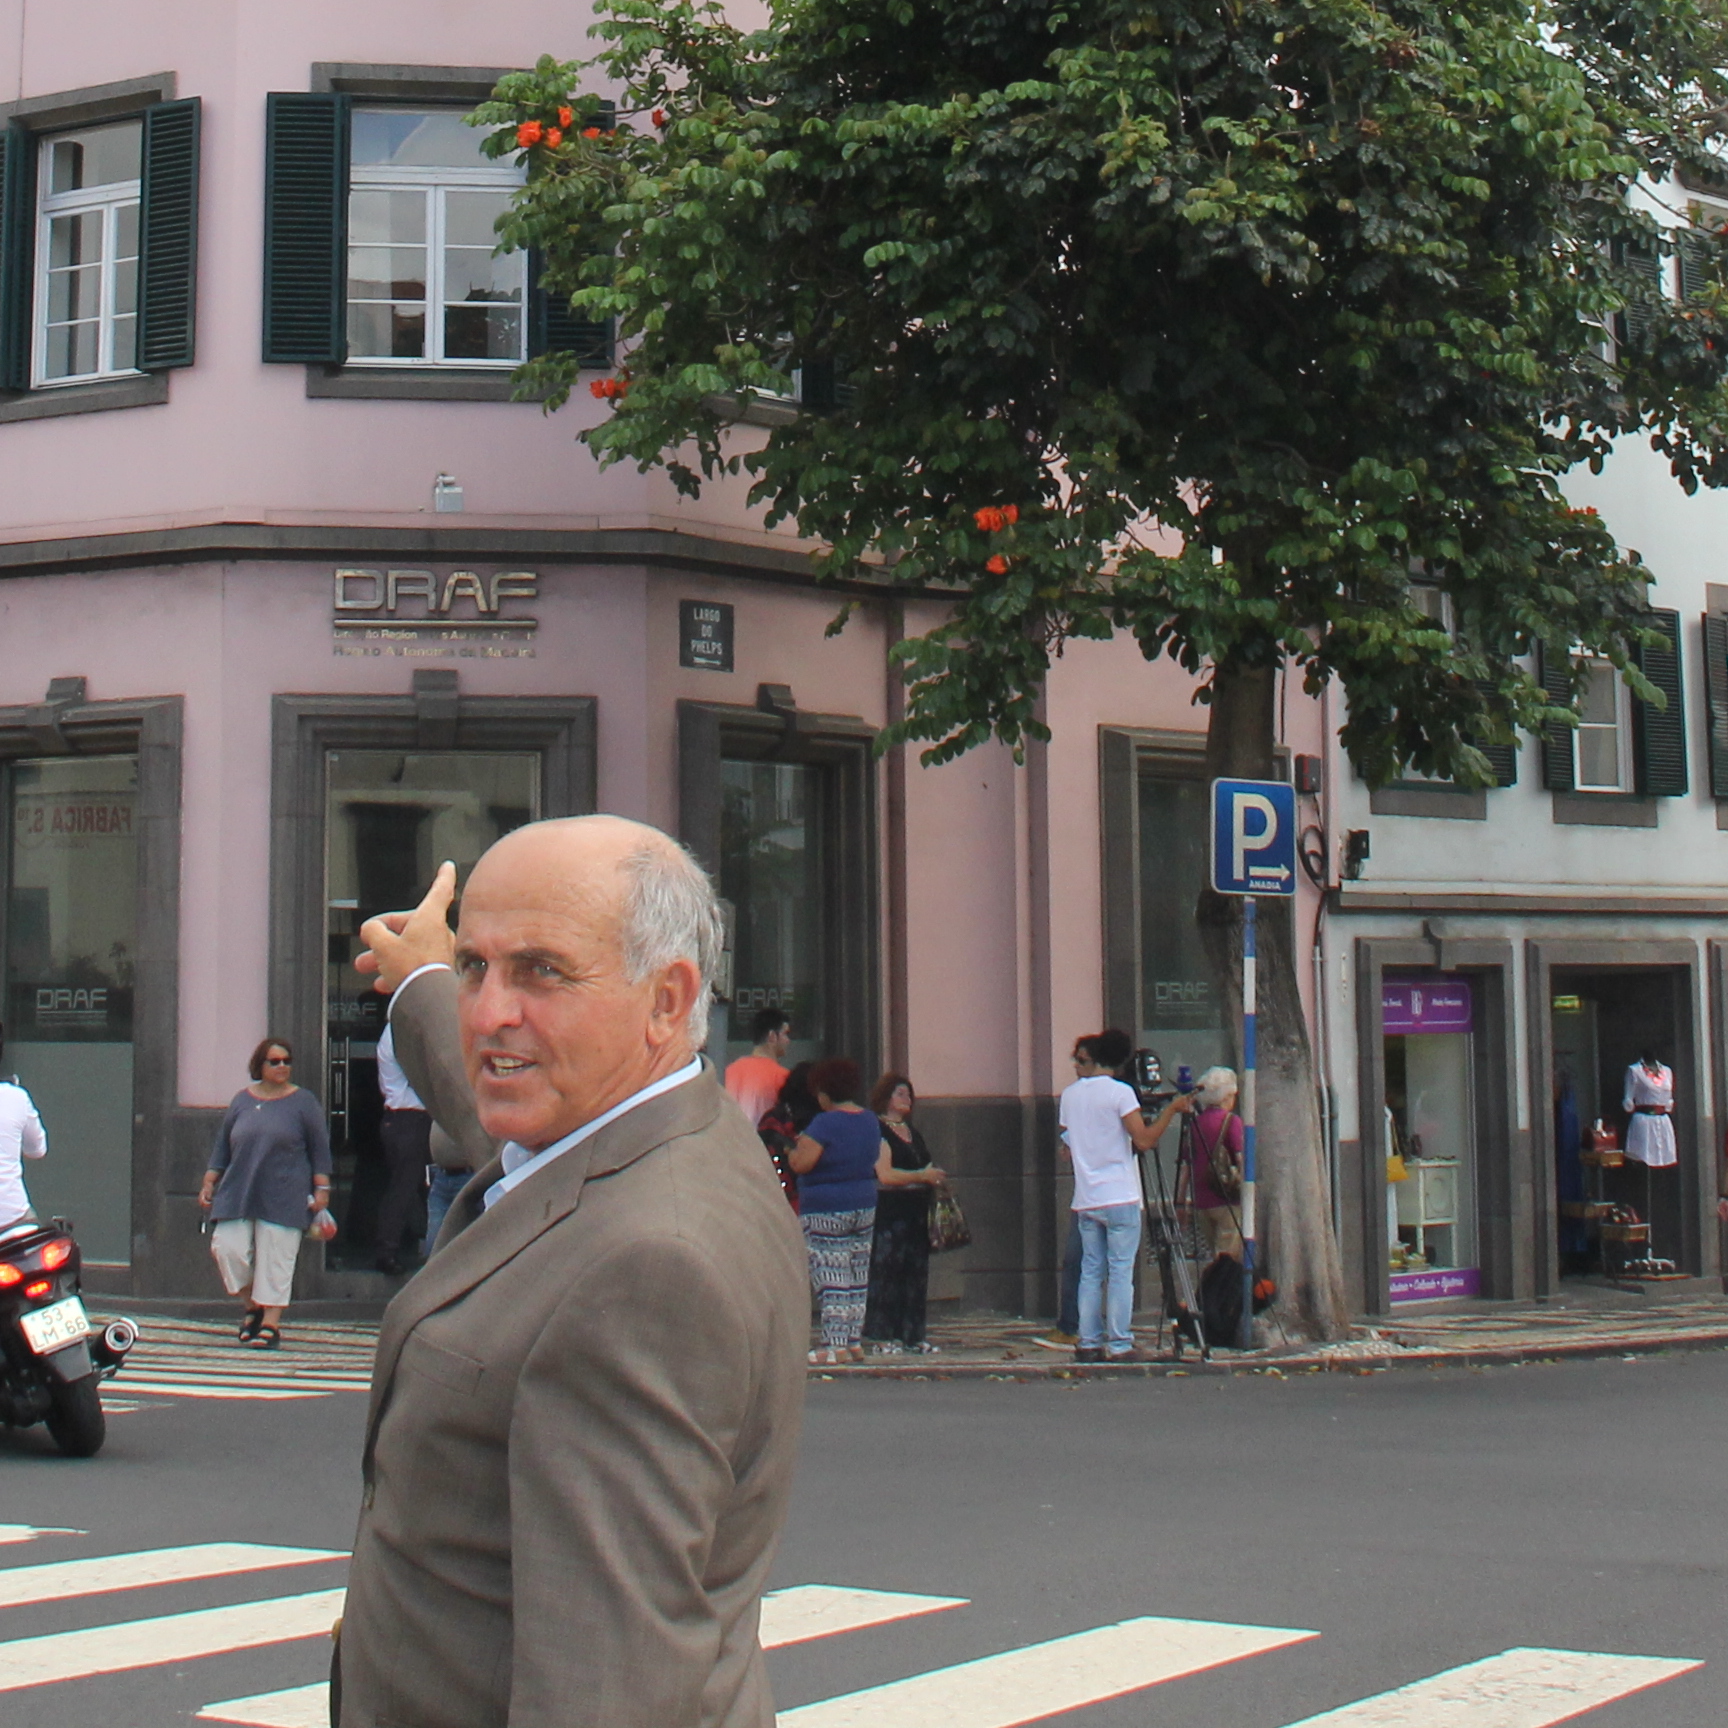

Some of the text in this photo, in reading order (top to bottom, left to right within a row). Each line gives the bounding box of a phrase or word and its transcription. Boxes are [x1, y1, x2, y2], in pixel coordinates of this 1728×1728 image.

[334, 568, 538, 612] DRAF
[693, 608, 721, 622] LARGO
[701, 624, 712, 637] DO
[691, 639, 723, 655] PHELPS
[1232, 791, 1278, 880] P
[1248, 879, 1282, 891] ANADIA
[36, 987, 108, 1010] DRAF
[735, 987, 795, 1008] DRAF
[1155, 980, 1209, 1001] DRAF
[40, 1306, 64, 1326] 53
